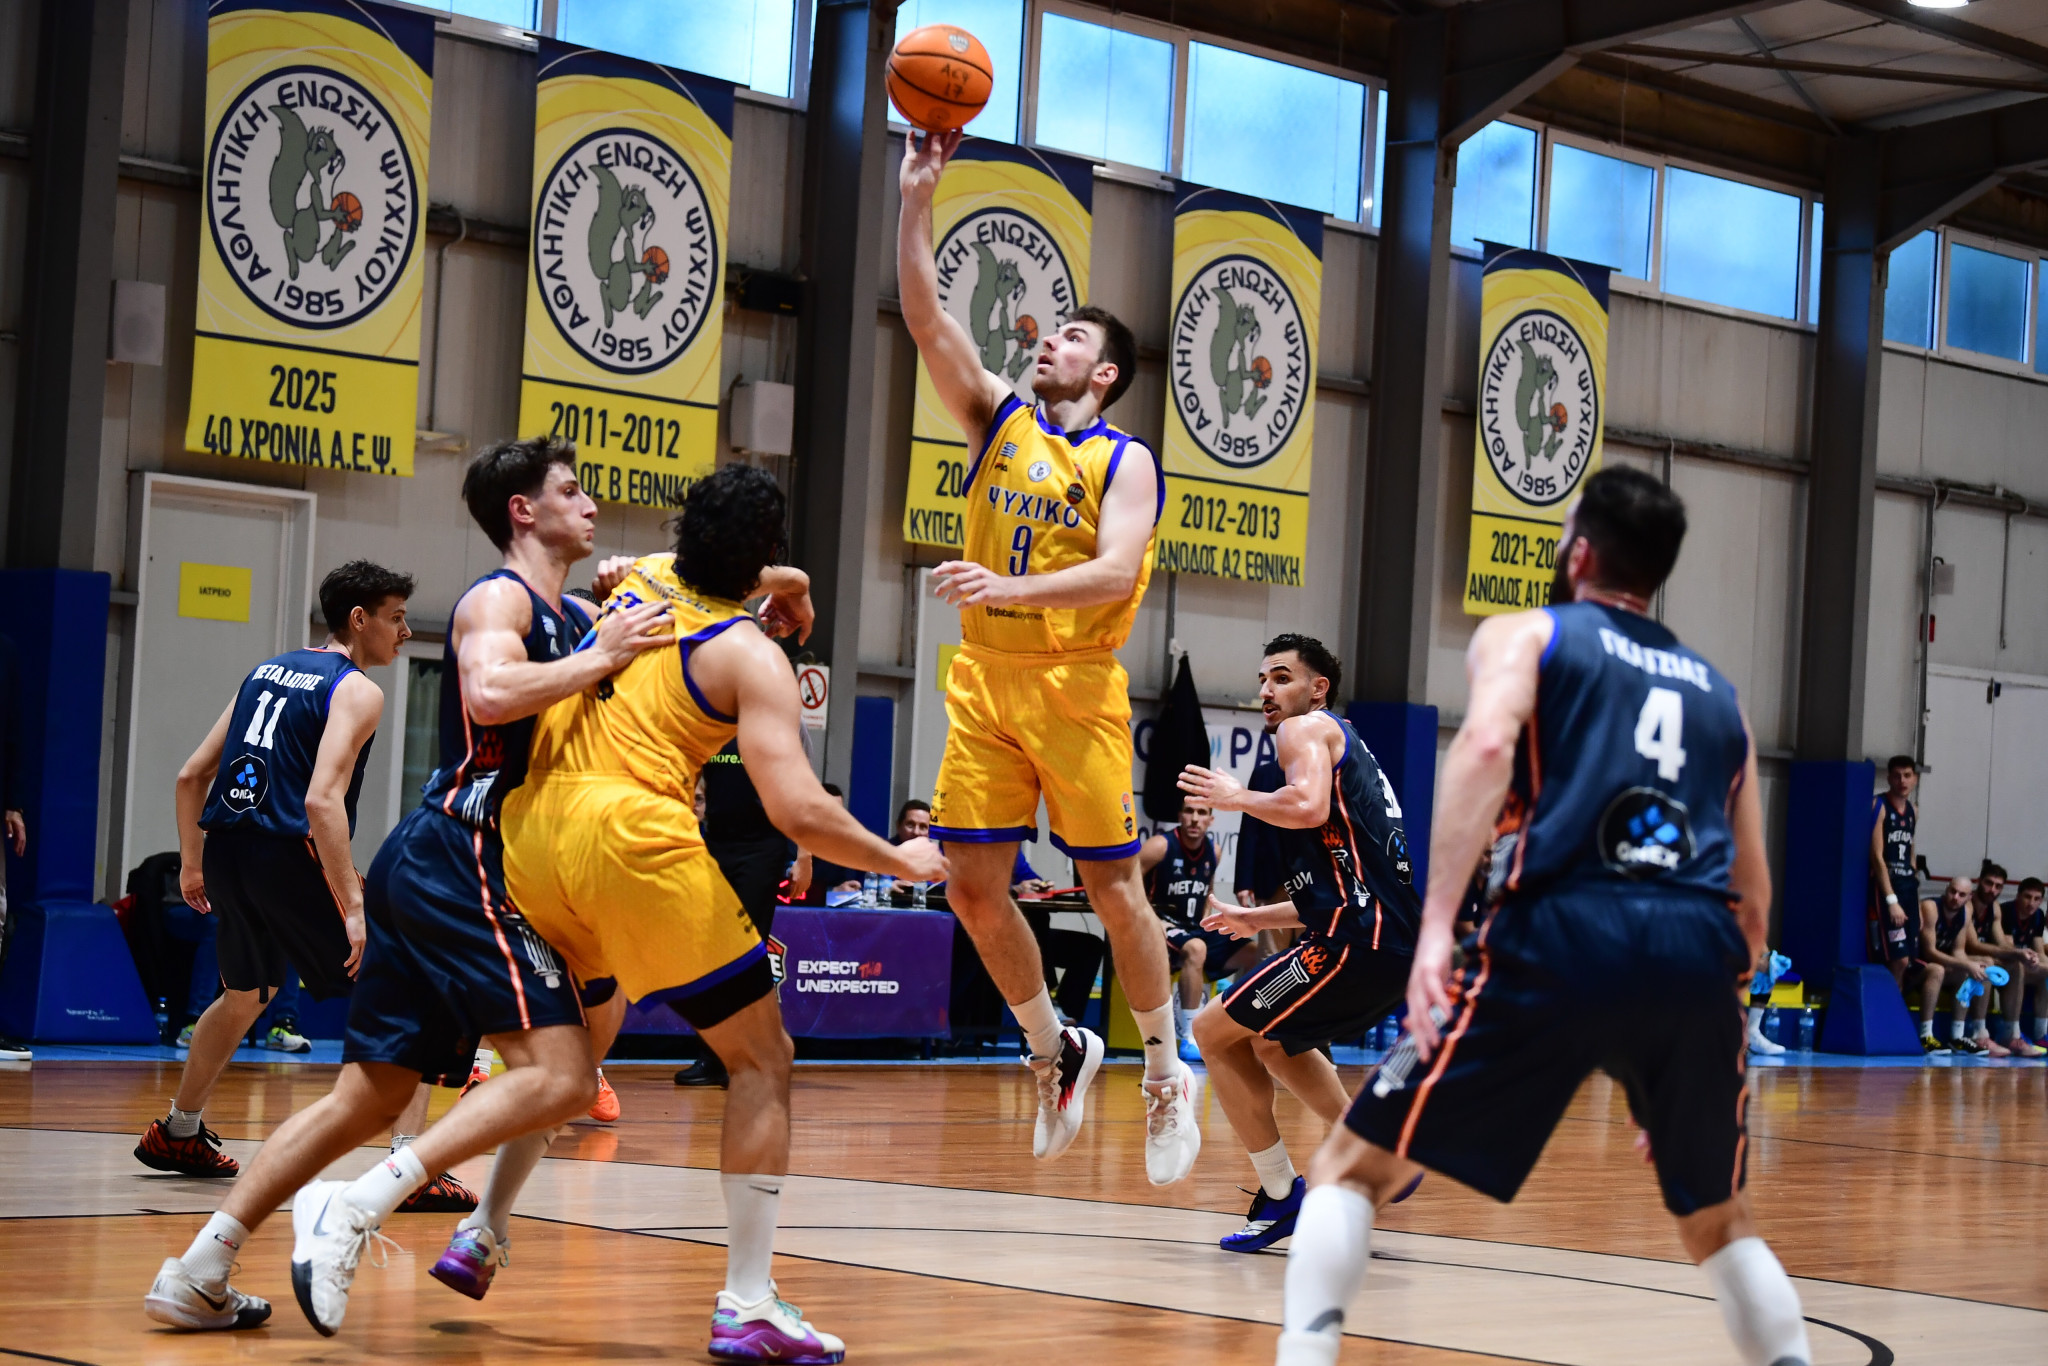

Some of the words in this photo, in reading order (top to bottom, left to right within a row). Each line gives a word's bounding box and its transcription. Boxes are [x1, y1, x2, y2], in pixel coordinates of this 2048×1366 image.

[217, 100, 272, 282] ΑΘΛΗΤΙΚΗ
[277, 80, 381, 142] ΕΝΩΣΗ
[354, 149, 406, 302] ΨΥΧΙΚΟΥ
[543, 160, 590, 330] ΑΘΛΗΤΙΚΗ
[596, 141, 687, 199] ΕΝΩΣΗ
[662, 206, 707, 350] ΨΥΧΙΚΟΥ
[976, 219, 1053, 270] ΕΝΩΣΗ
[273, 279, 344, 317] 1985
[592, 328, 653, 362] 1985
[1176, 284, 1212, 431] ΑΘΛΗΤΙΚΗ
[1217, 266, 1285, 314] ΕΝΩΣΗ
[1266, 320, 1302, 446] ΨΥΧΙΚΟΥ
[269, 364, 337, 414] 2025
[1485, 337, 1516, 473] ΑΘΛΗΤΙΚΗ
[1520, 320, 1579, 363] ΕΝΩΣΗ
[1562, 369, 1591, 486] ΨΥΧΙΚΟΥ
[203, 414, 232, 457] 40
[239, 418, 324, 467] ΧΡΟΝΙΑ
[330, 430, 397, 475] Α.Ε.Ψ.
[550, 401, 681, 459] 2011-2012
[1212, 428, 1260, 457] 1985
[935, 459, 968, 498] 20
[1516, 469, 1557, 496] 1985
[910, 508, 964, 545] ΚΥΠΕΛ
[988, 486, 1080, 529] ΨΥΧΙΚΟ
[1180, 493, 1280, 540] 2012-2013
[1007, 525, 1033, 577] 9
[1157, 538, 1219, 577] ΑΝΟΔΟΣ
[1222, 548, 1241, 579] Α2
[1245, 550, 1300, 586] ΕΘΝΙΚΗ
[198, 585, 232, 598] ΙΑΤΡΕΙΟ
[1468, 572, 1521, 607] ΑΝΟΔΟΣ
[1524, 578, 1540, 608] Α1
[243, 690, 288, 750] 11
[1634, 686, 1687, 783] 4
[1186, 897, 1197, 918] 0
[796, 979, 900, 994] UNEXPECTED
[797, 960, 859, 975] EXPECT
